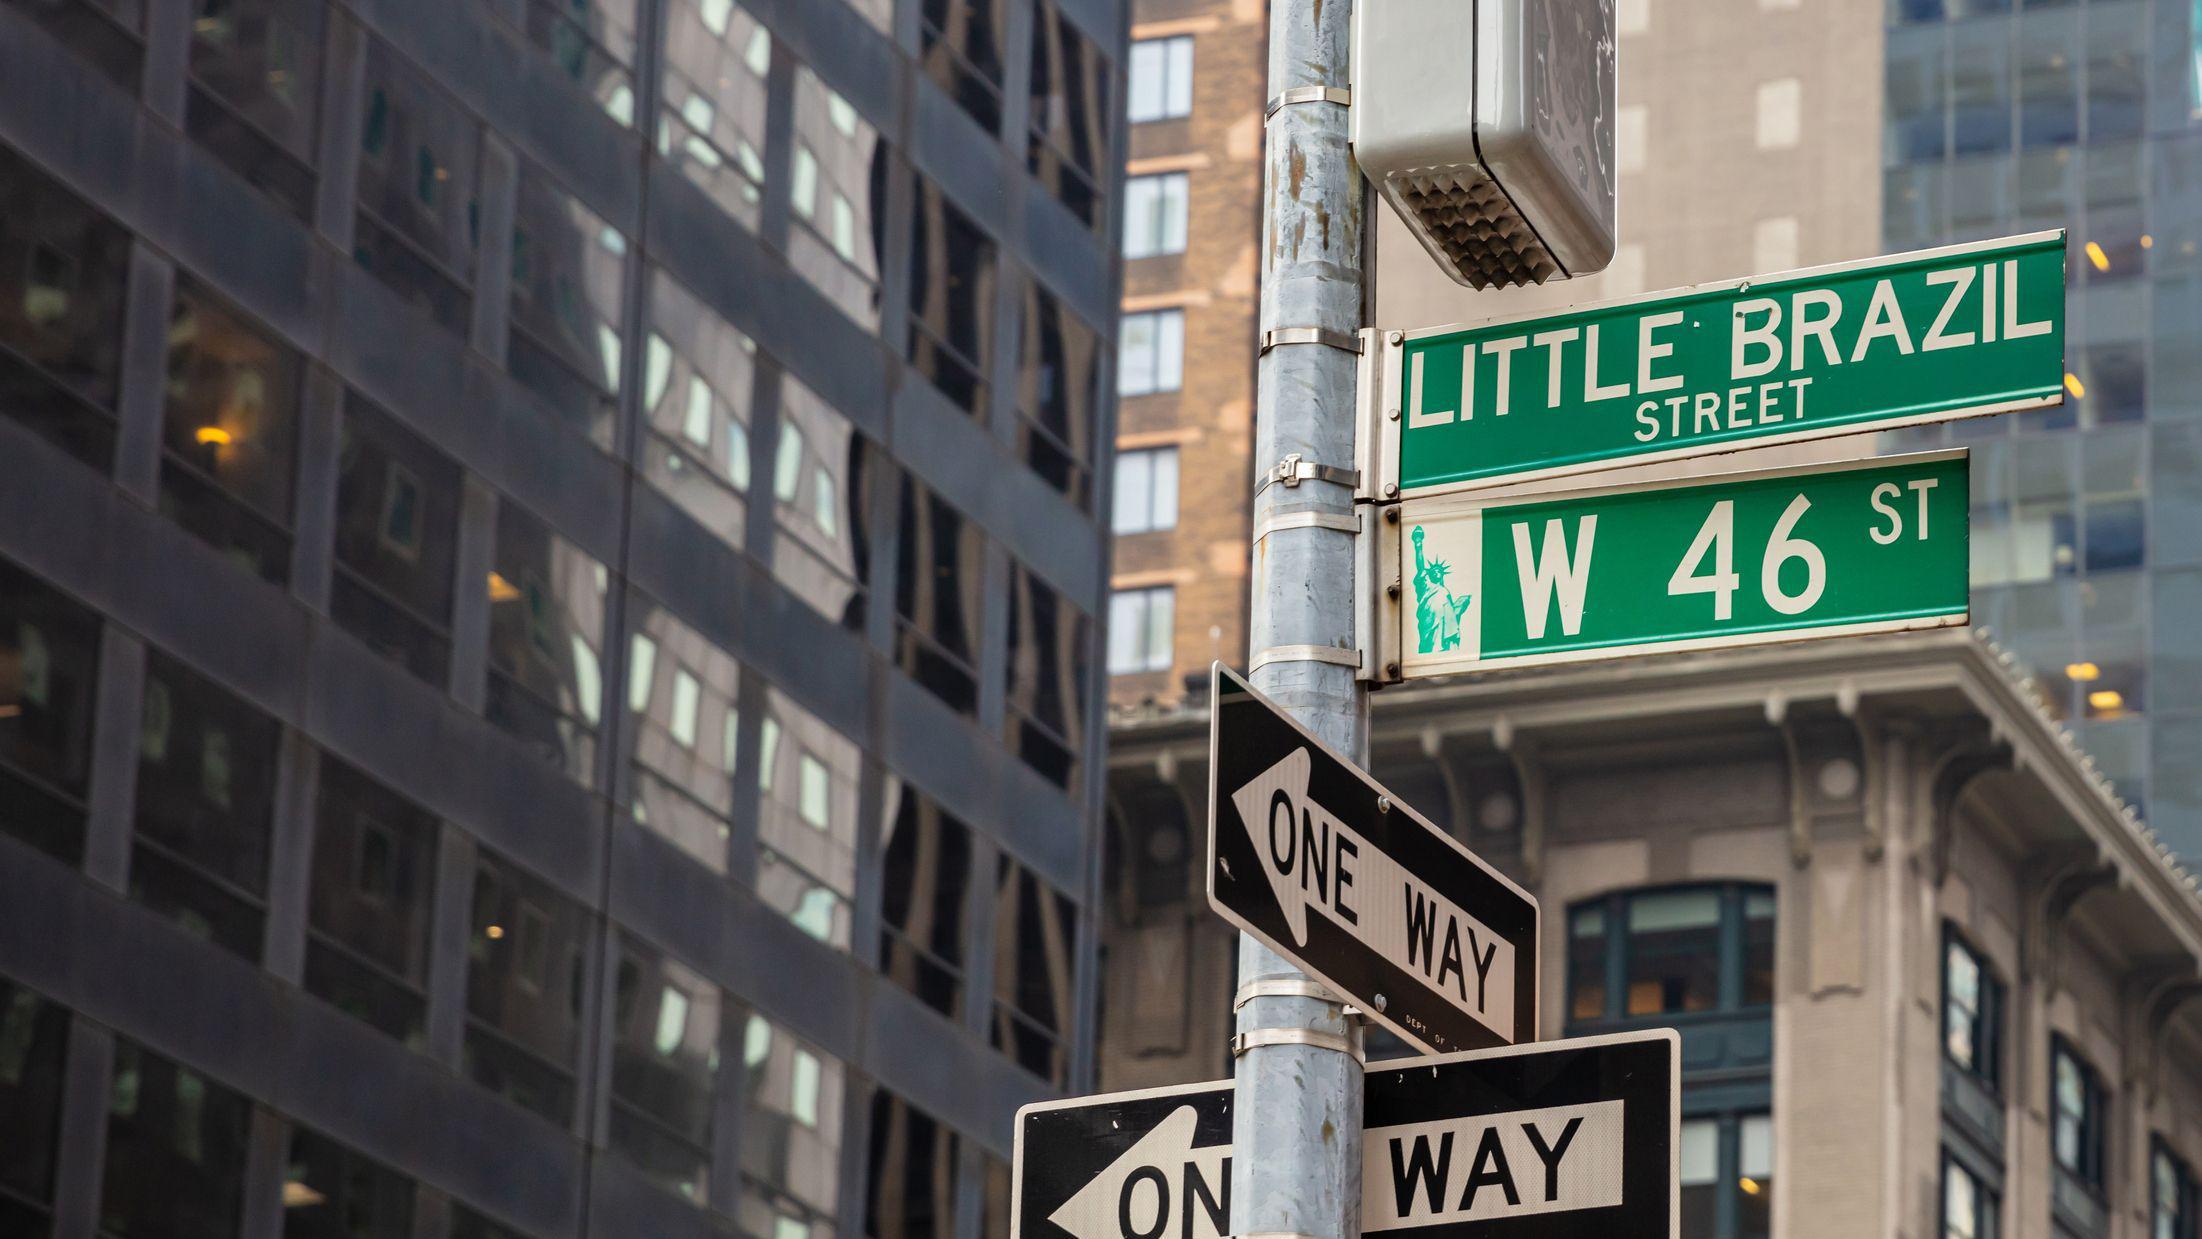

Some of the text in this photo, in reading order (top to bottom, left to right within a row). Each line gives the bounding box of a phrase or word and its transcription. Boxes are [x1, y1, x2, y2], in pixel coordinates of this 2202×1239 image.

[1408, 259, 2053, 429] LITTLE BRAZIL
[1634, 377, 1813, 442] STREET
[1511, 478, 1938, 640] W 46 ST
[1269, 788, 1497, 1014] ONE WAY
[1406, 1014, 1446, 1045] DEPT OF
[1118, 1117, 1583, 1239] ON WAY
